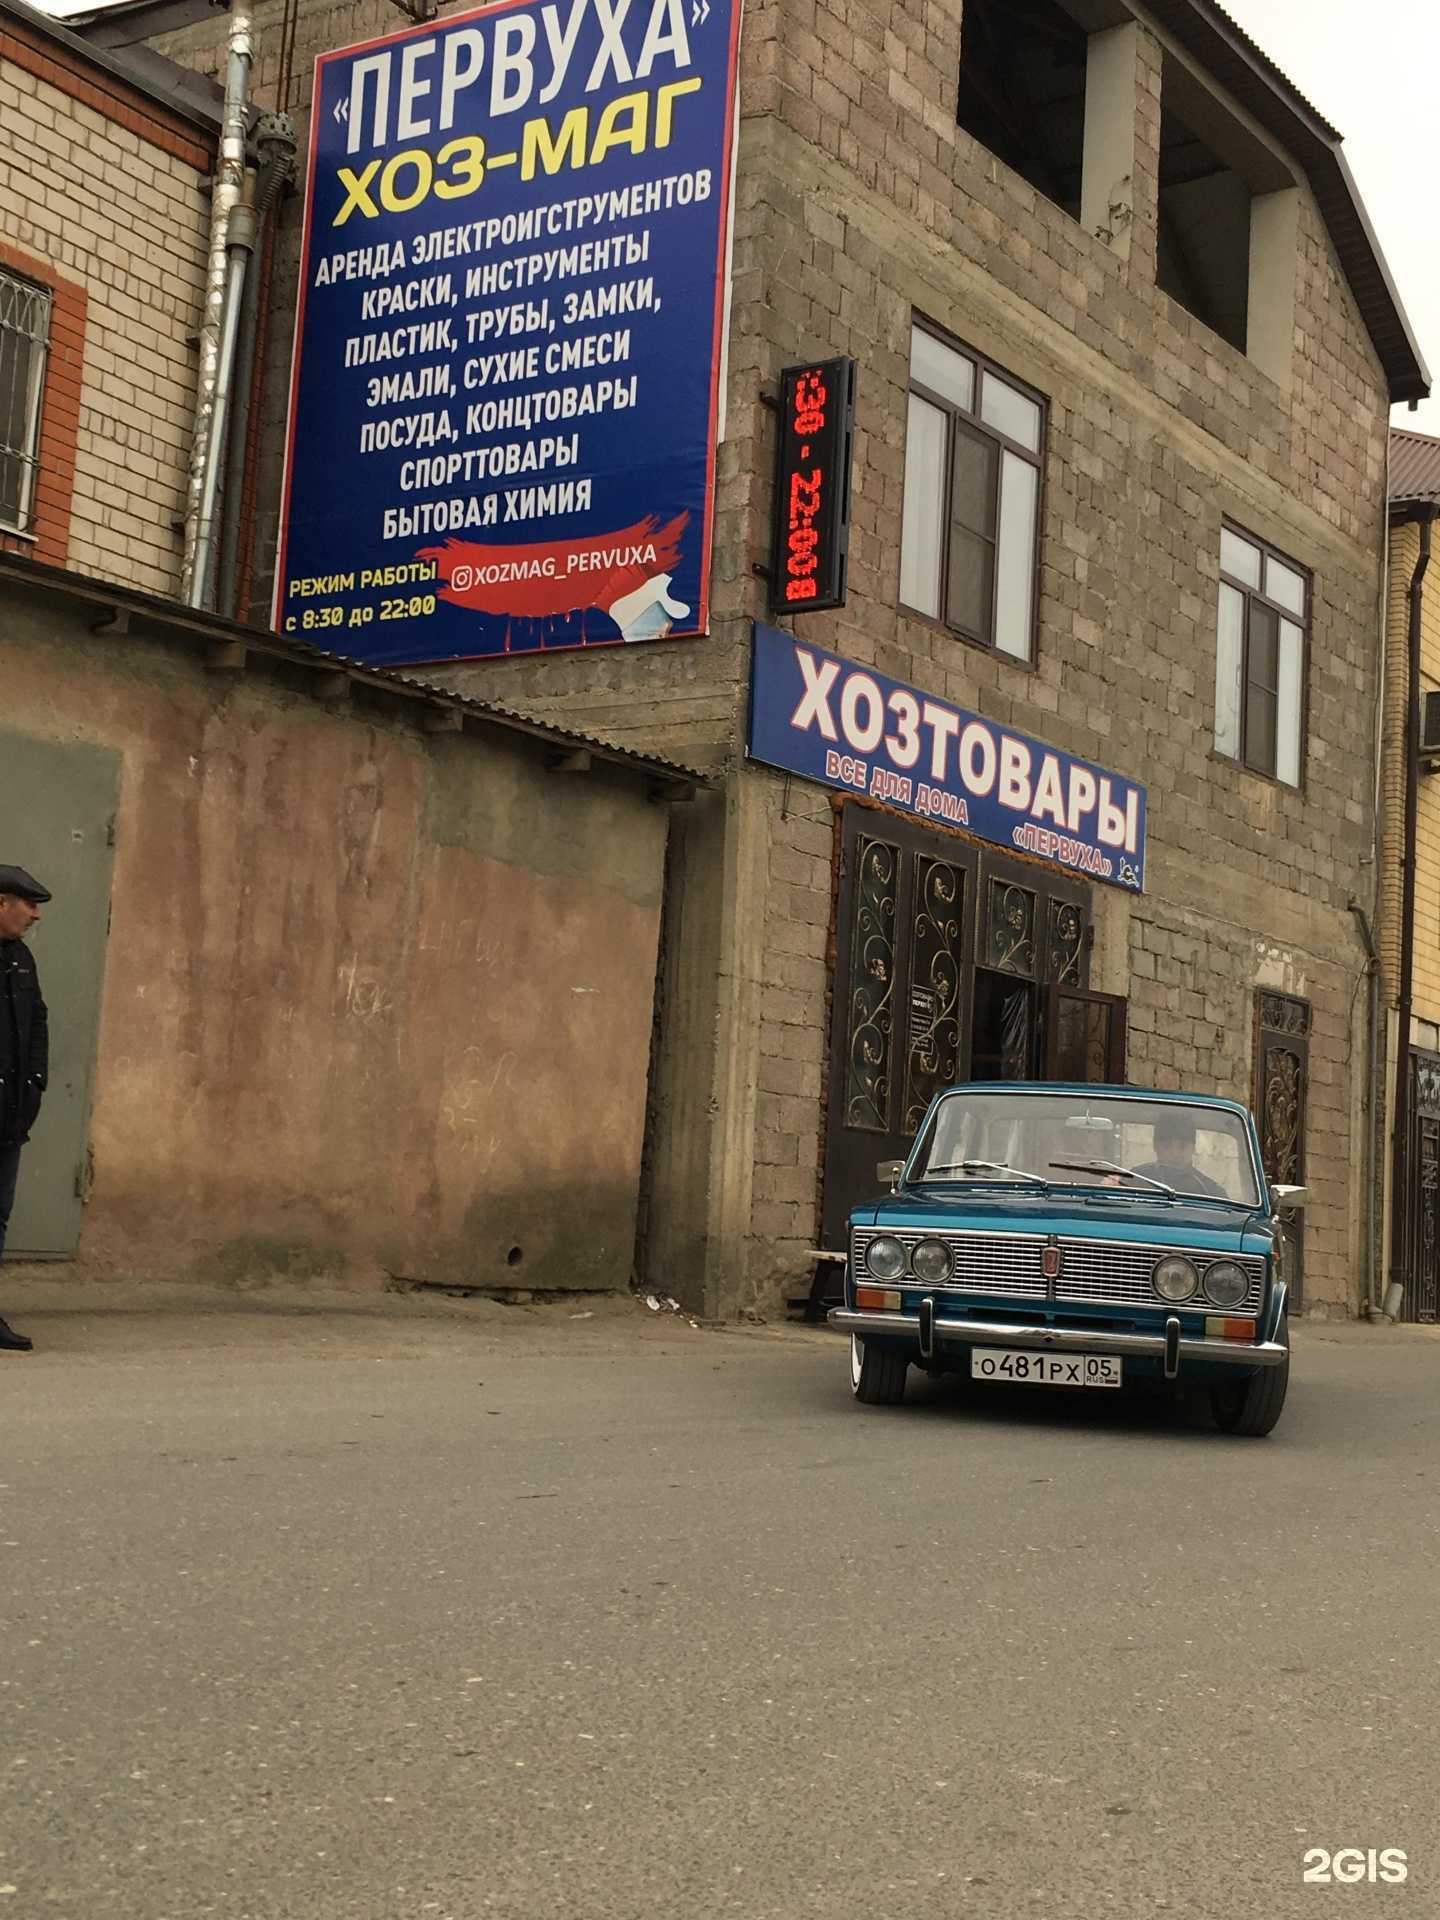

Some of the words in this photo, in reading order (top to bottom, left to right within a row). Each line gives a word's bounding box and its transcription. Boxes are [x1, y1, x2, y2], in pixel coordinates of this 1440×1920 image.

[333, 0, 711, 155] «ПЕРВУХА»
[332, 77, 702, 227] ХОЗ-МАГ
[315, 240, 406, 287] АРЕНДА
[411, 168, 712, 265] ЭЛЕКТРОИГСТРУМЕНТОВ
[361, 274, 458, 320] КРАСКИ,
[465, 230, 650, 299] ИНСТРУМЕНТЫ
[344, 318, 458, 368] ПЛАСТИК,
[466, 298, 556, 344] ТРУБЫ,
[563, 277, 661, 324] ЗАМКИ,
[366, 364, 456, 407] ЭМАЛИ,
[463, 346, 541, 389] СУХИЕ
[545, 329, 631, 374] СМЕСИ
[359, 412, 458, 453] ПОСУДА,
[465, 375, 638, 435] КОНЦТОВАРЫ
[399, 434, 579, 491] СПОРТТОВАРЫ
[383, 493, 498, 540] БЫТОВАЯ
[503, 478, 592, 523] ХИМИЯ
[788, 468, 822, 576] 22:00
[289, 570, 355, 598] РЕЖИМ
[360, 561, 437, 589] РАБОТЫ
[474, 544, 657, 584] XOZMAG_PERVUXA
[285, 616, 297, 632] с
[302, 607, 344, 630] 8:30
[348, 603, 374, 626] до
[380, 595, 436, 621] 22:00
[791, 646, 1139, 853] ХОЗТОВАРЫ
[826, 750, 867, 787] ВСЕ
[870, 766, 912, 804] ДЛЯ
[914, 784, 969, 826] ДОМА
[1011, 823, 1112, 877] «ПЕРВУХА»
[1086, 1376, 1105, 1384] RUS
[1087, 1359, 1112, 1377] 05
